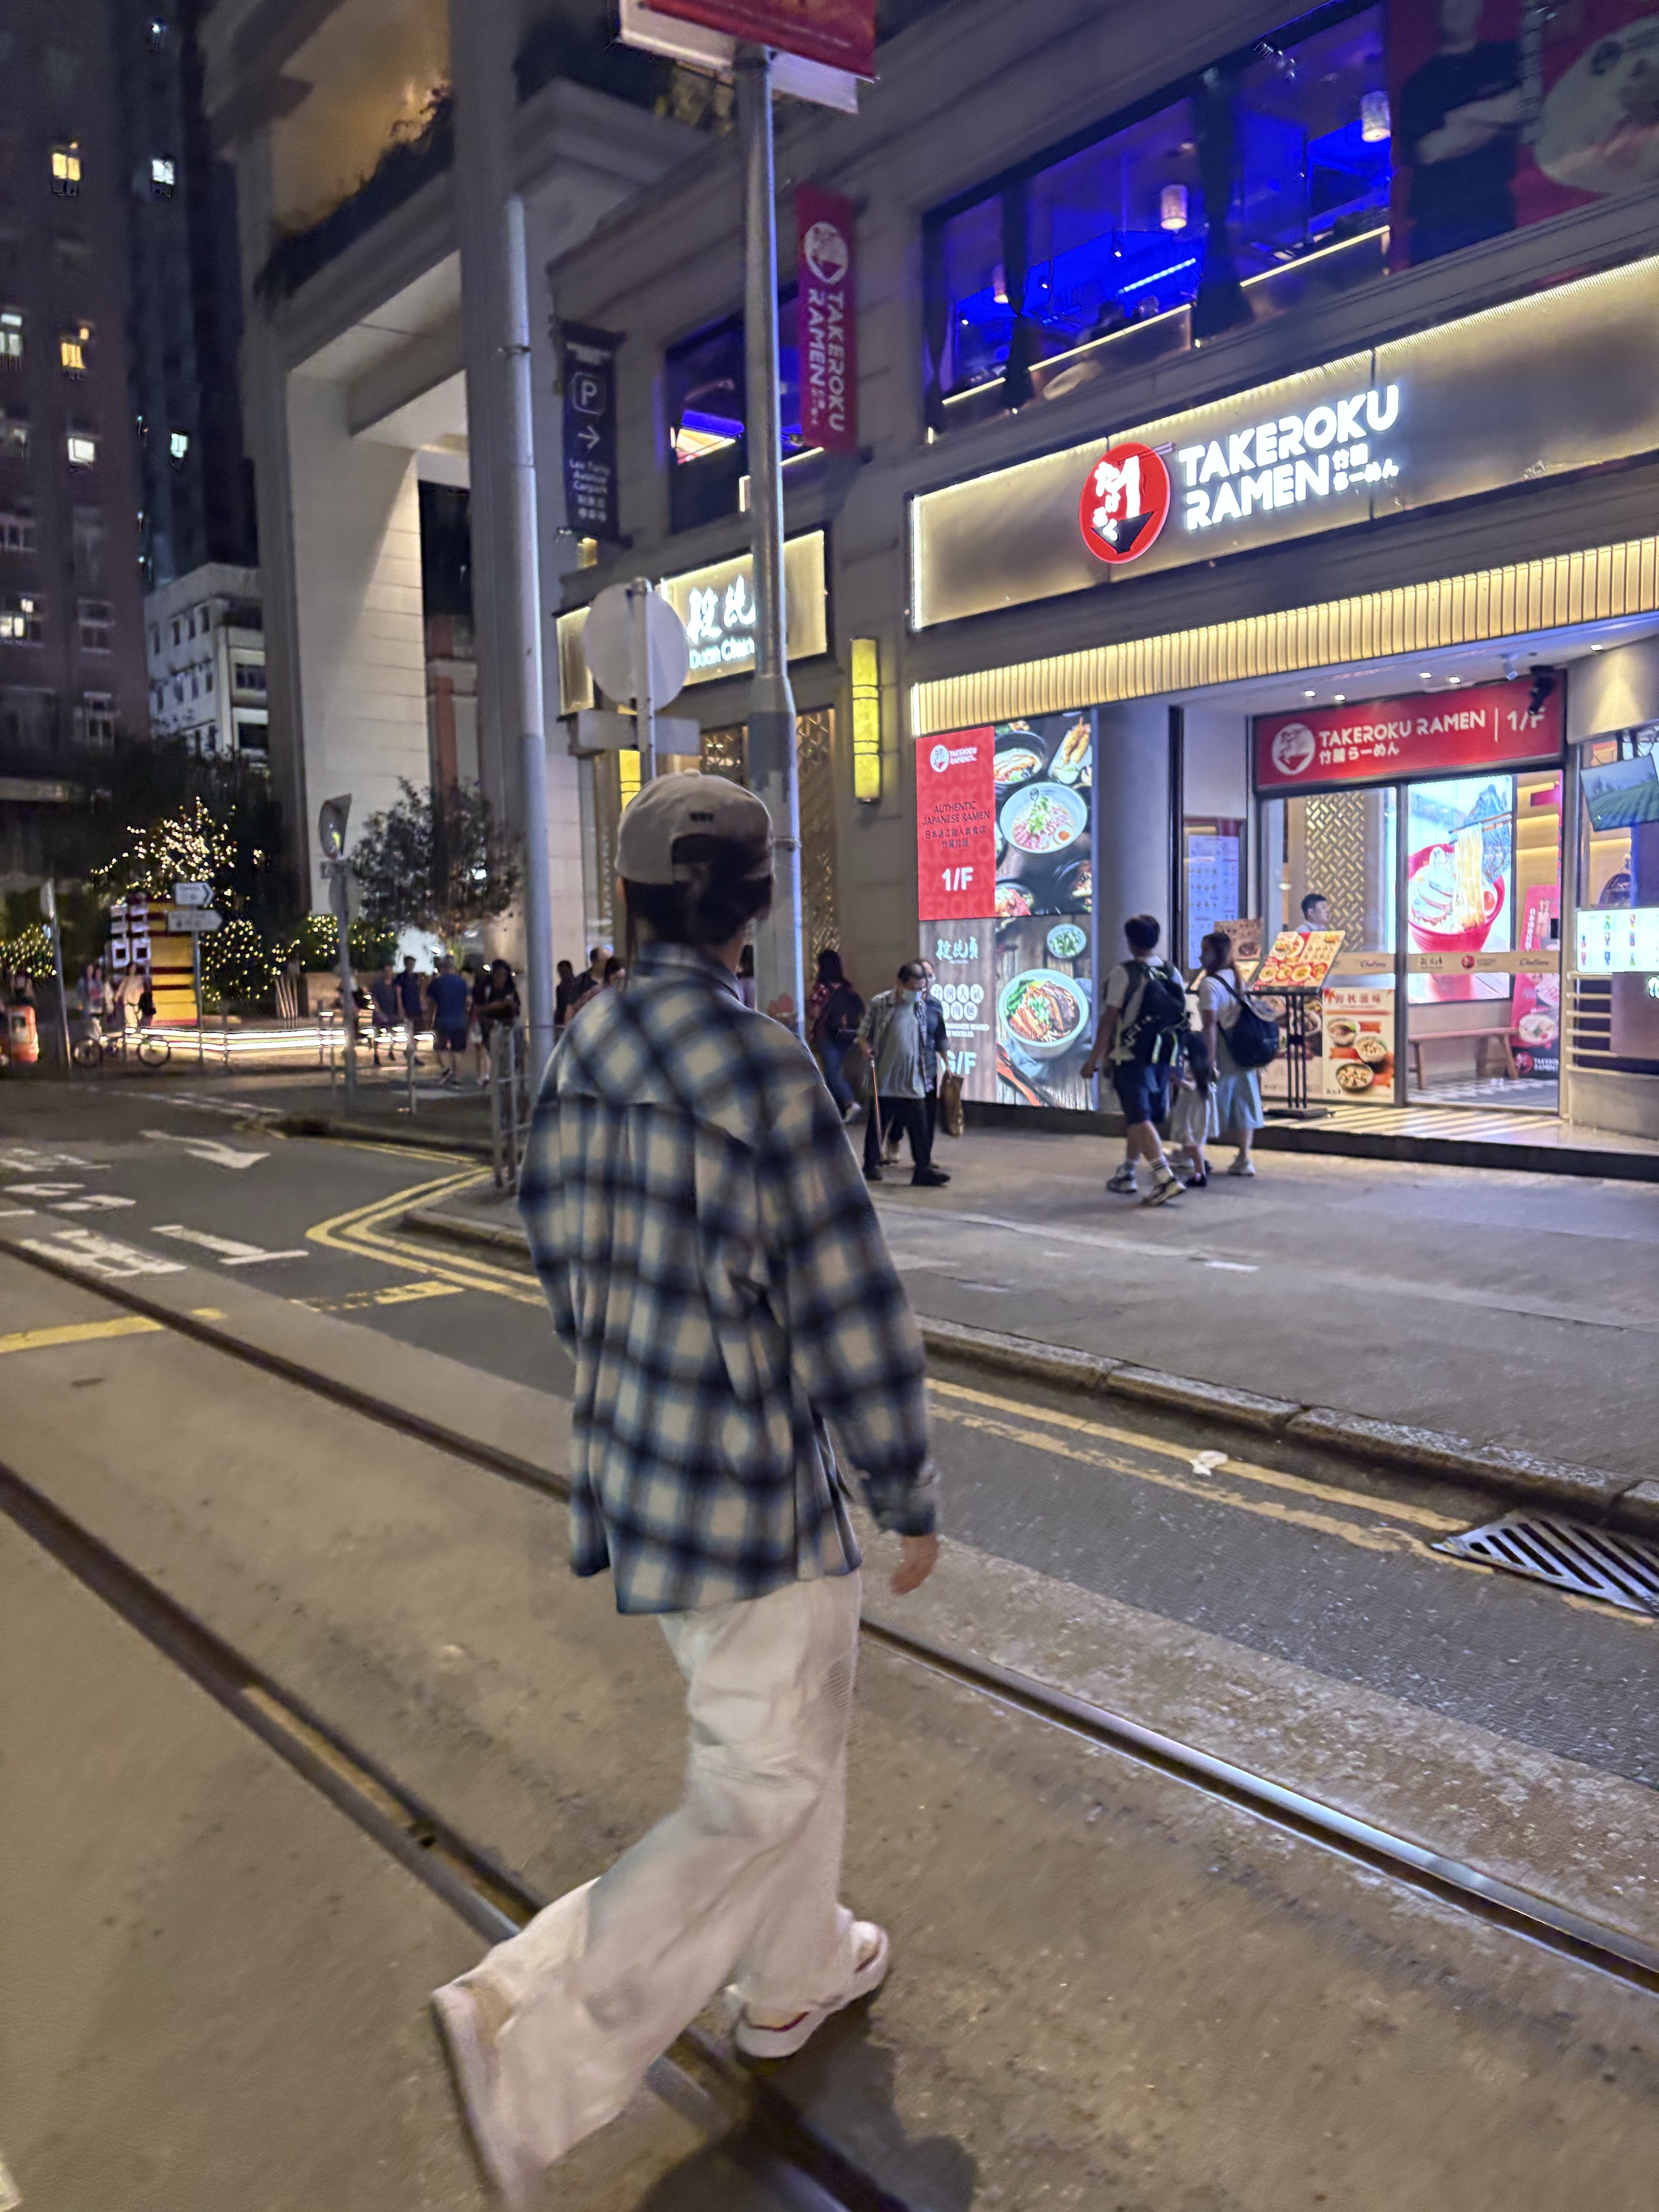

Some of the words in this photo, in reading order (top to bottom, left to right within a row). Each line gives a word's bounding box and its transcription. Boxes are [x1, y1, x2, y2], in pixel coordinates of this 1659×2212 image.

[808, 288, 826, 386] RAMEN
[827, 290, 845, 432] TAKEROKU
[1178, 385, 1399, 487] TAKEROKU
[1186, 454, 1329, 531] RAMEN
[1319, 720, 1411, 748] TAKEROKU
[1417, 709, 1486, 735] RAMEN
[1506, 706, 1546, 731] 1/F
[923, 814, 960, 825] JAPANESE
[962, 811, 990, 821] RAMEN
[934, 801, 976, 812] AUTHENTIC
[942, 867, 973, 891] 1/F
[940, 1050, 977, 1075] G/F
